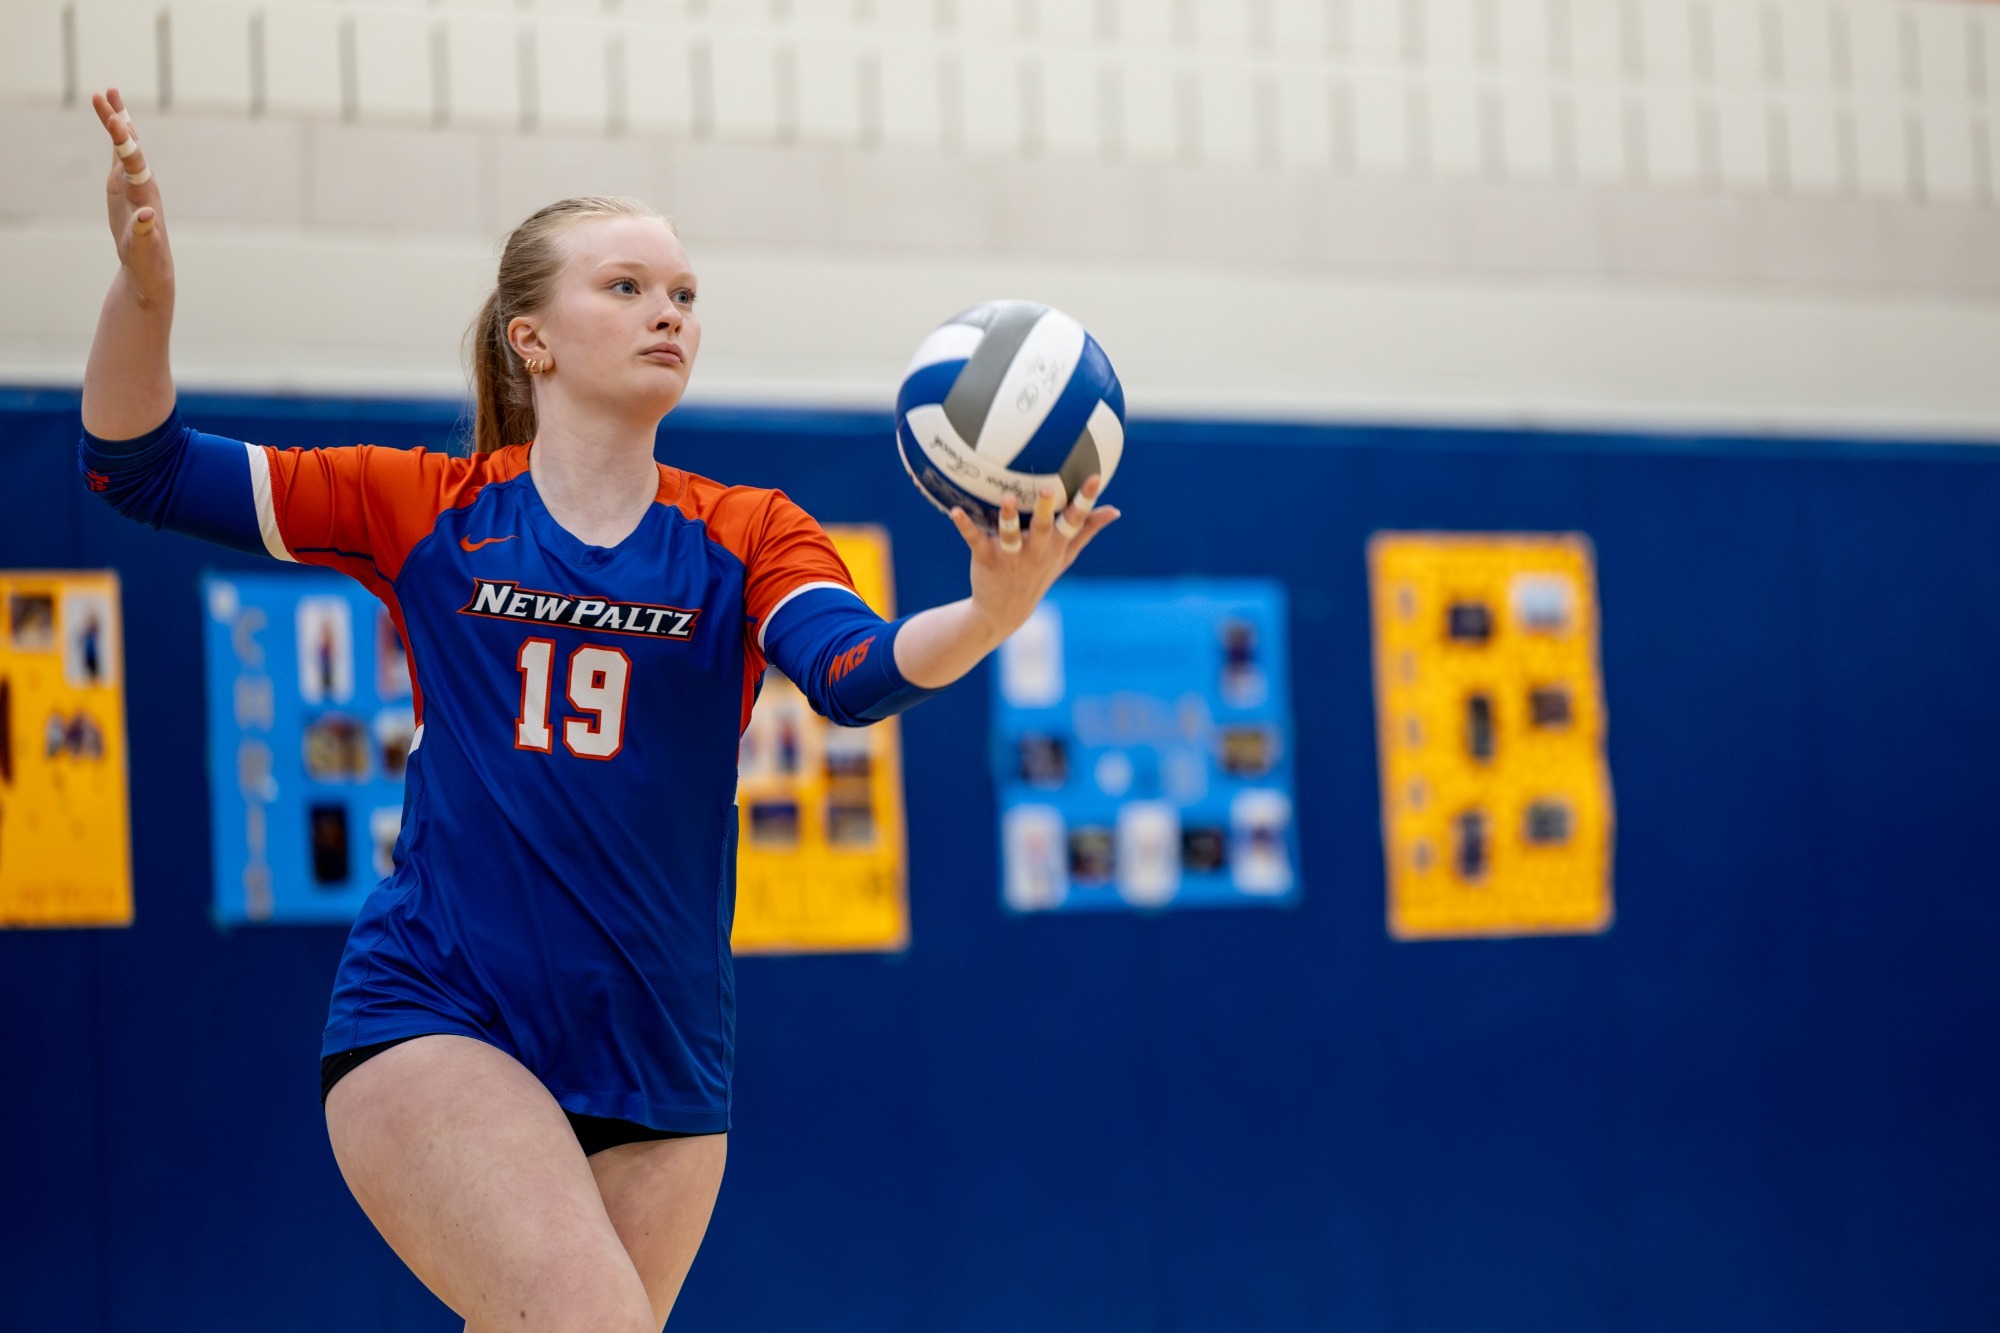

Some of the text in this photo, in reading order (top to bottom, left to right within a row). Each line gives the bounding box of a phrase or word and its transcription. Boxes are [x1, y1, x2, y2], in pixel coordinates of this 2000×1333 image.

[472, 583, 694, 636] NEW PALTZ
[514, 637, 632, 761] 19
